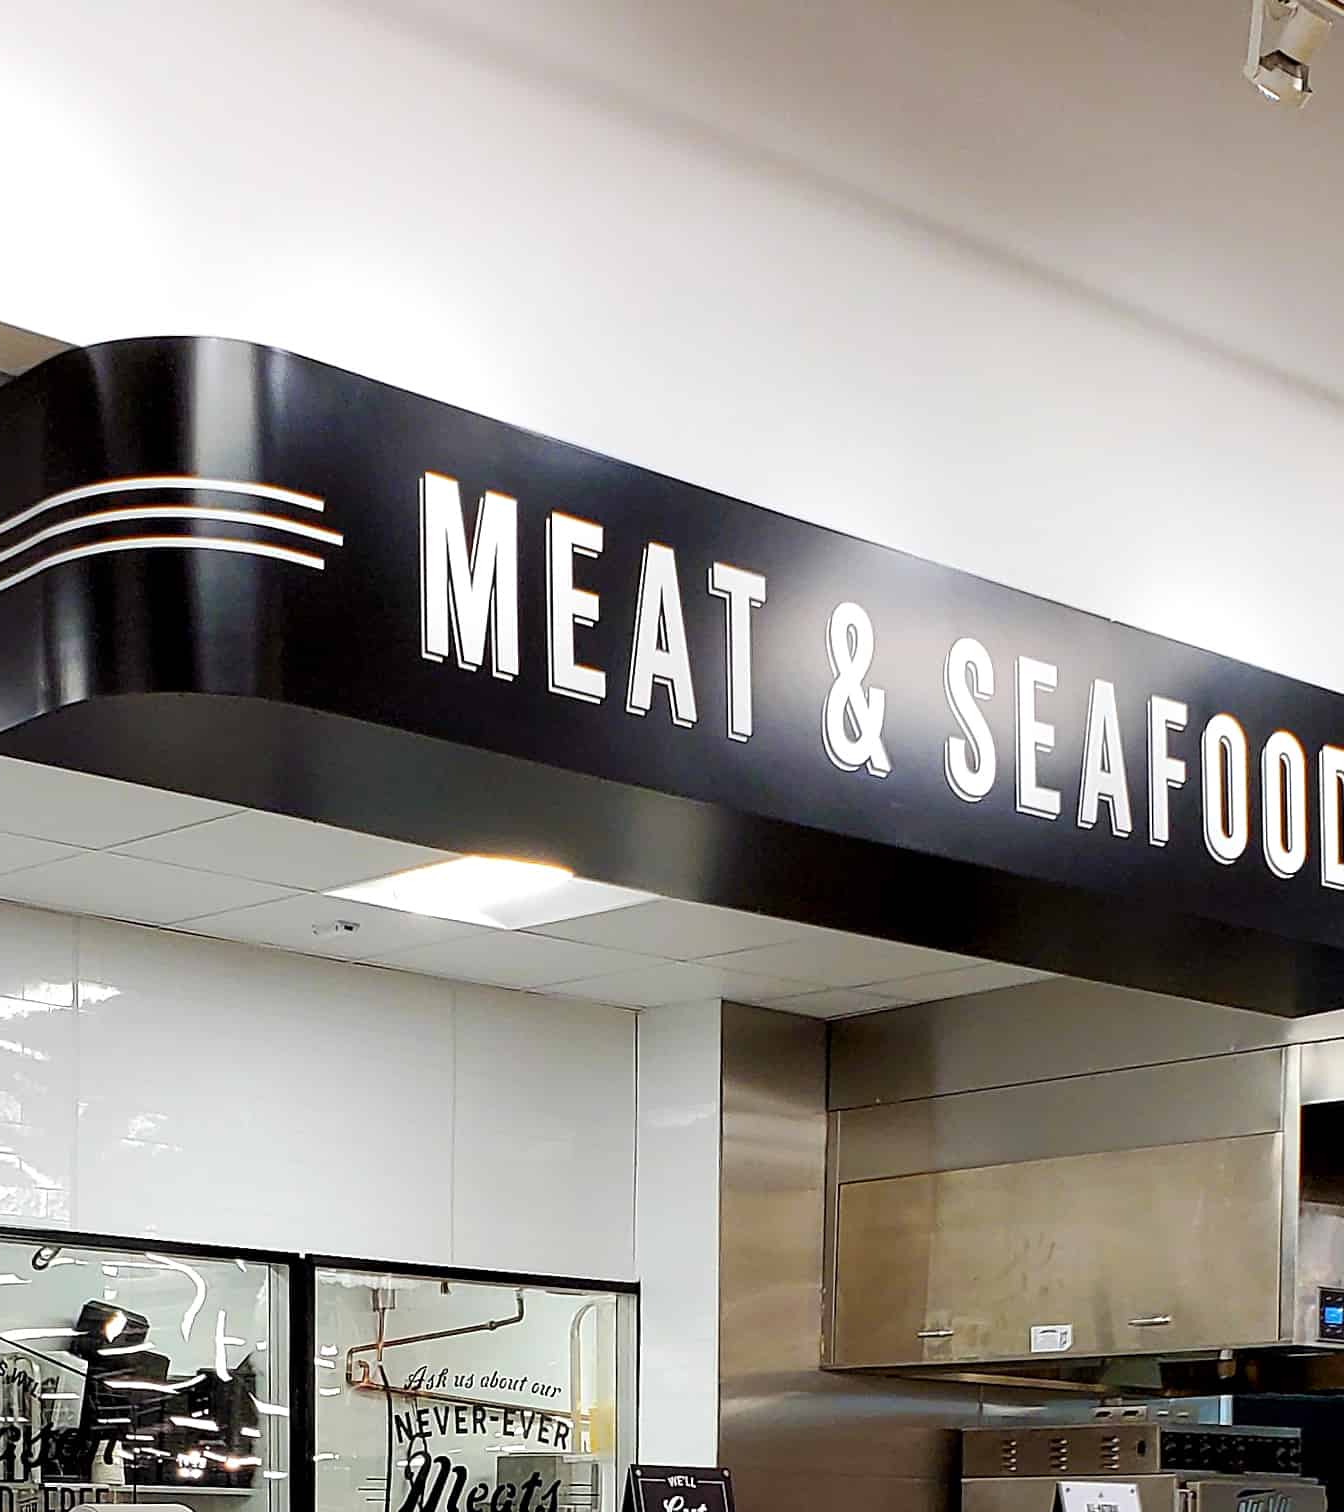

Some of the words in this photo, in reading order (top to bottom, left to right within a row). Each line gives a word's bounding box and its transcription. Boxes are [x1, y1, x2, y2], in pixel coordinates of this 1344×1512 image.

[419, 470, 767, 743] MEAT
[822, 601, 892, 777] &
[404, 1366, 447, 1393] Ask
[454, 1371, 474, 1390] us
[480, 1368, 528, 1393] about
[531, 1382, 563, 1399] our
[394, 1404, 570, 1450] NEVER-EVER
[667, 1475, 696, 1488] WE'LL
